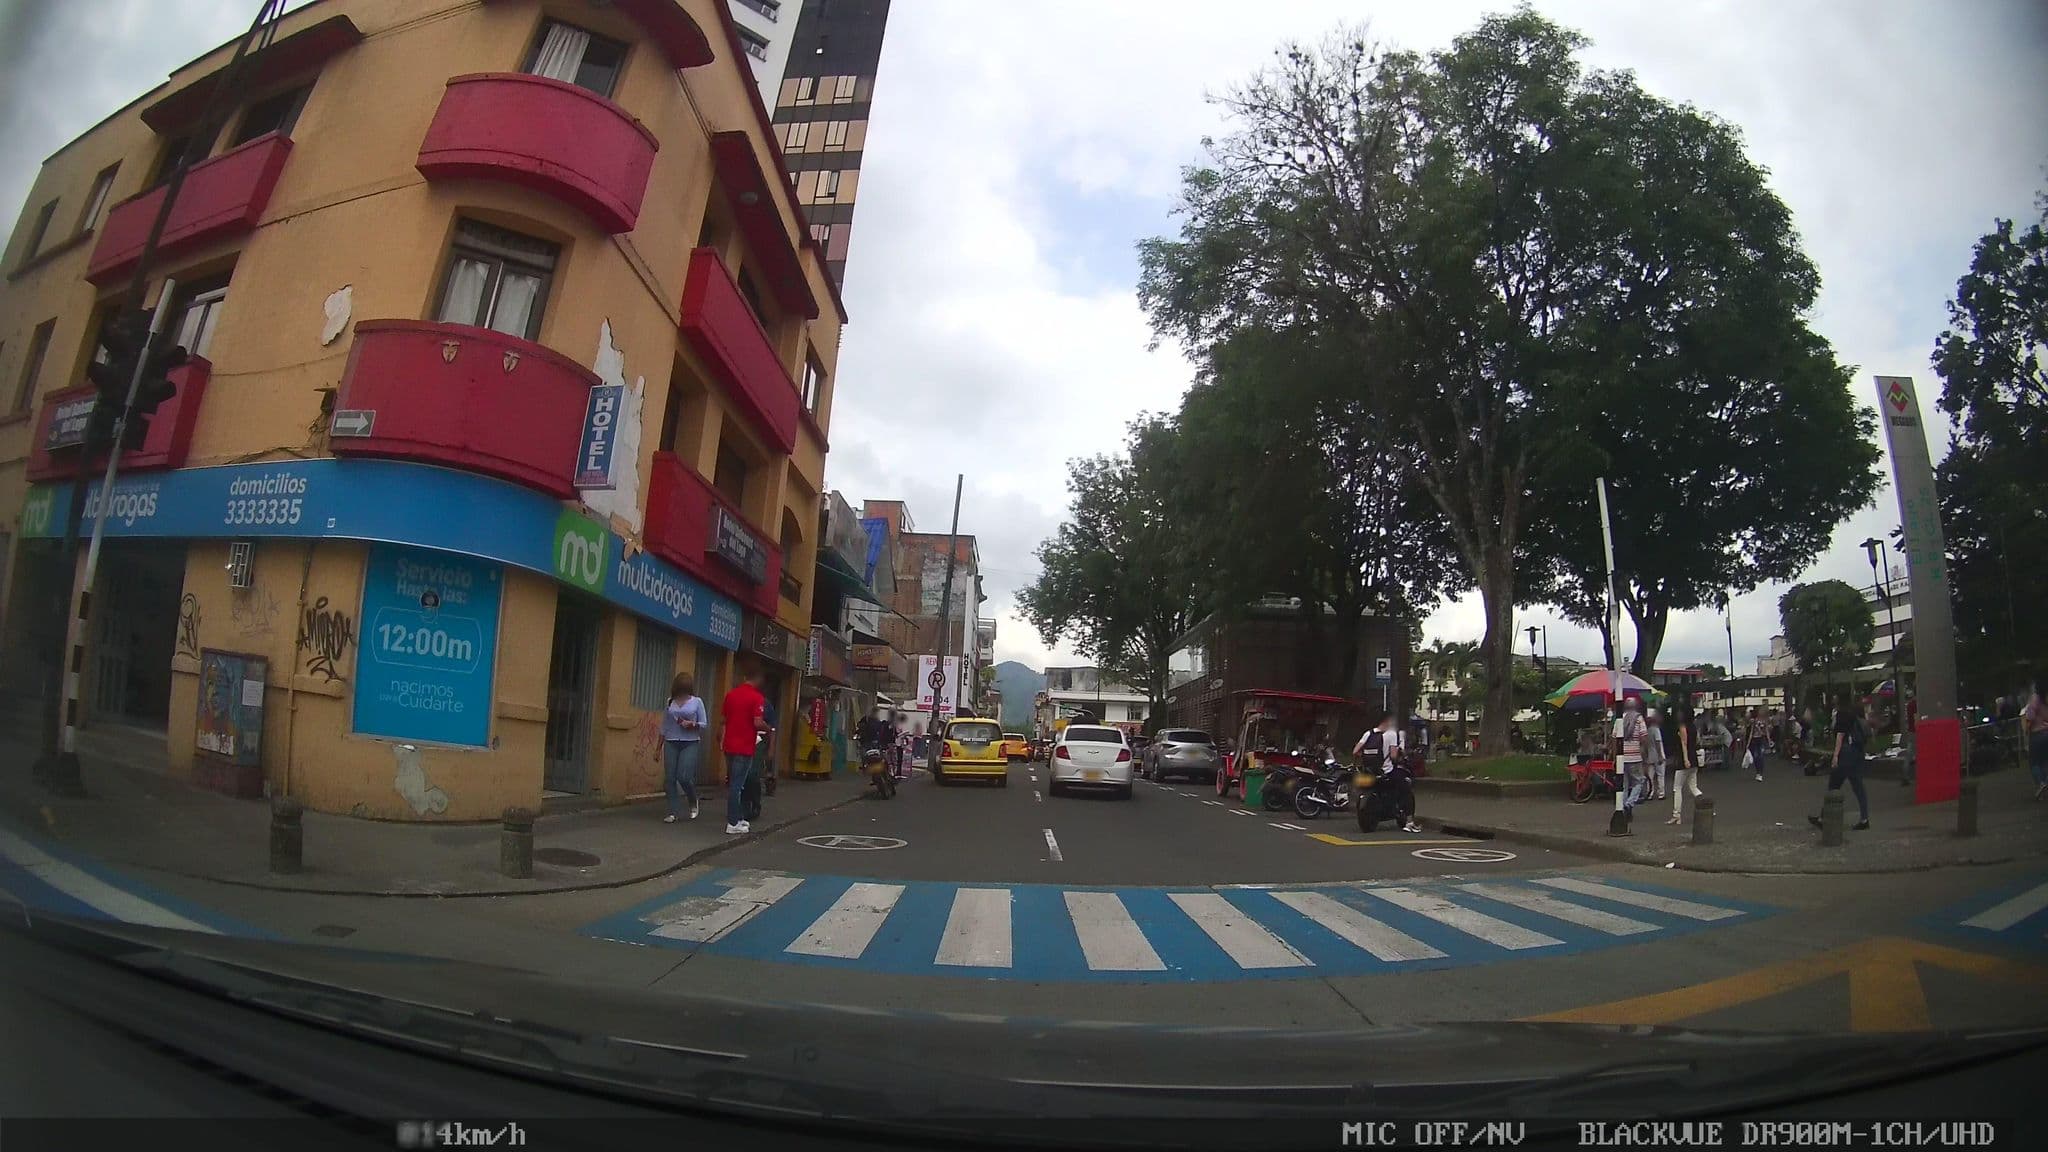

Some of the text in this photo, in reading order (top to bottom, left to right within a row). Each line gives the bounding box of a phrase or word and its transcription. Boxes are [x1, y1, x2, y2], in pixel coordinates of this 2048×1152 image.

[587, 397, 614, 470] HOTEL
[230, 472, 307, 495] domicilios
[224, 499, 303, 524] 3333335
[395, 558, 472, 588] Servicio
[560, 530, 693, 619] md multidrogas
[378, 623, 473, 662] 12:00m
[391, 679, 454, 698] nacimos
[399, 692, 464, 713] Cuidarte
